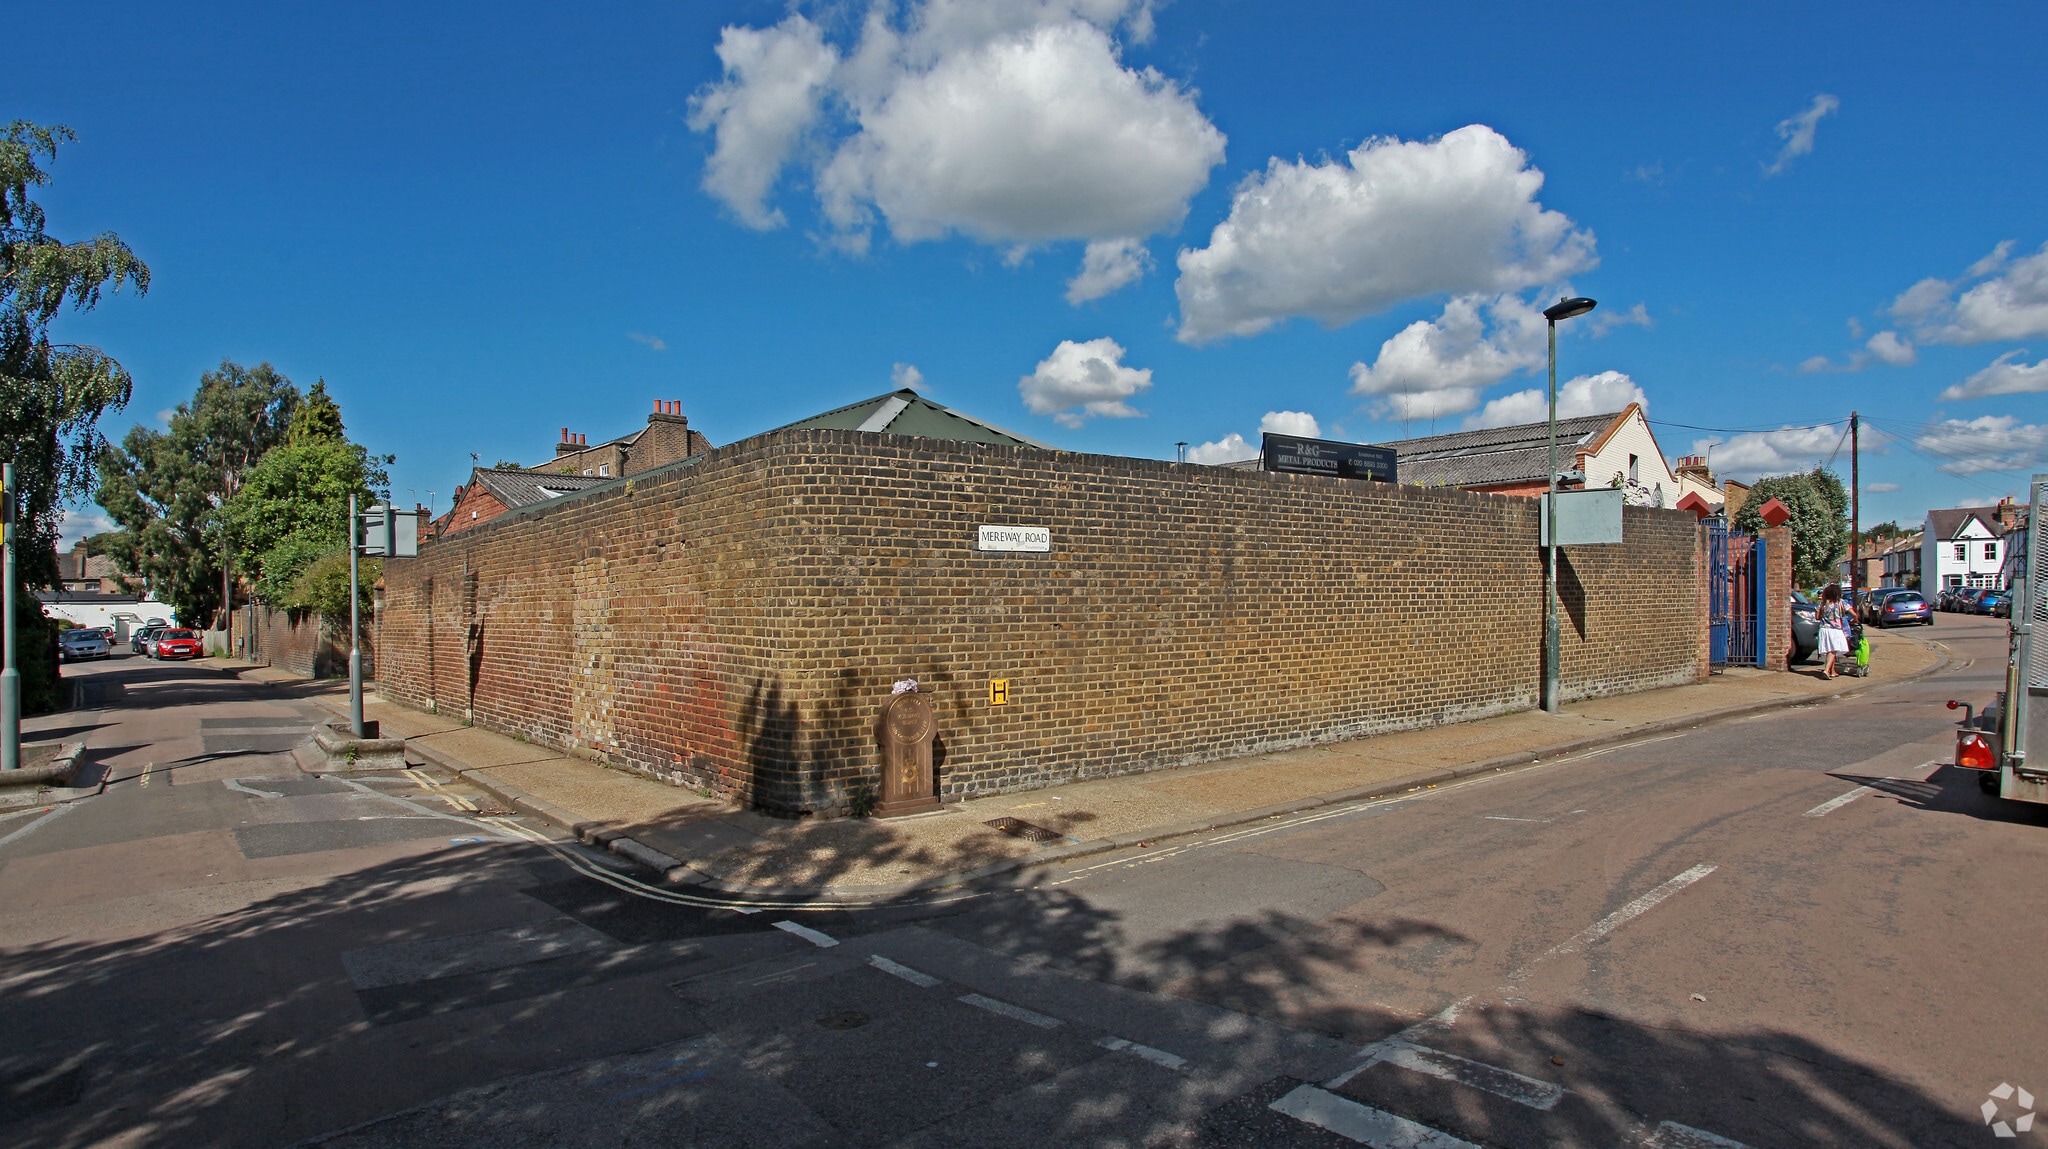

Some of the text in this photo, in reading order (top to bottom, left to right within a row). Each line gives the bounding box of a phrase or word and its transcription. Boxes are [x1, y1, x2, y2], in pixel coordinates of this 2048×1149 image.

[1296, 442, 1319, 457] R&G
[1278, 454, 1338, 469] METAL PRODUCTS
[981, 531, 1048, 543] MEREWAY ROAD
[993, 681, 1006, 703] H
